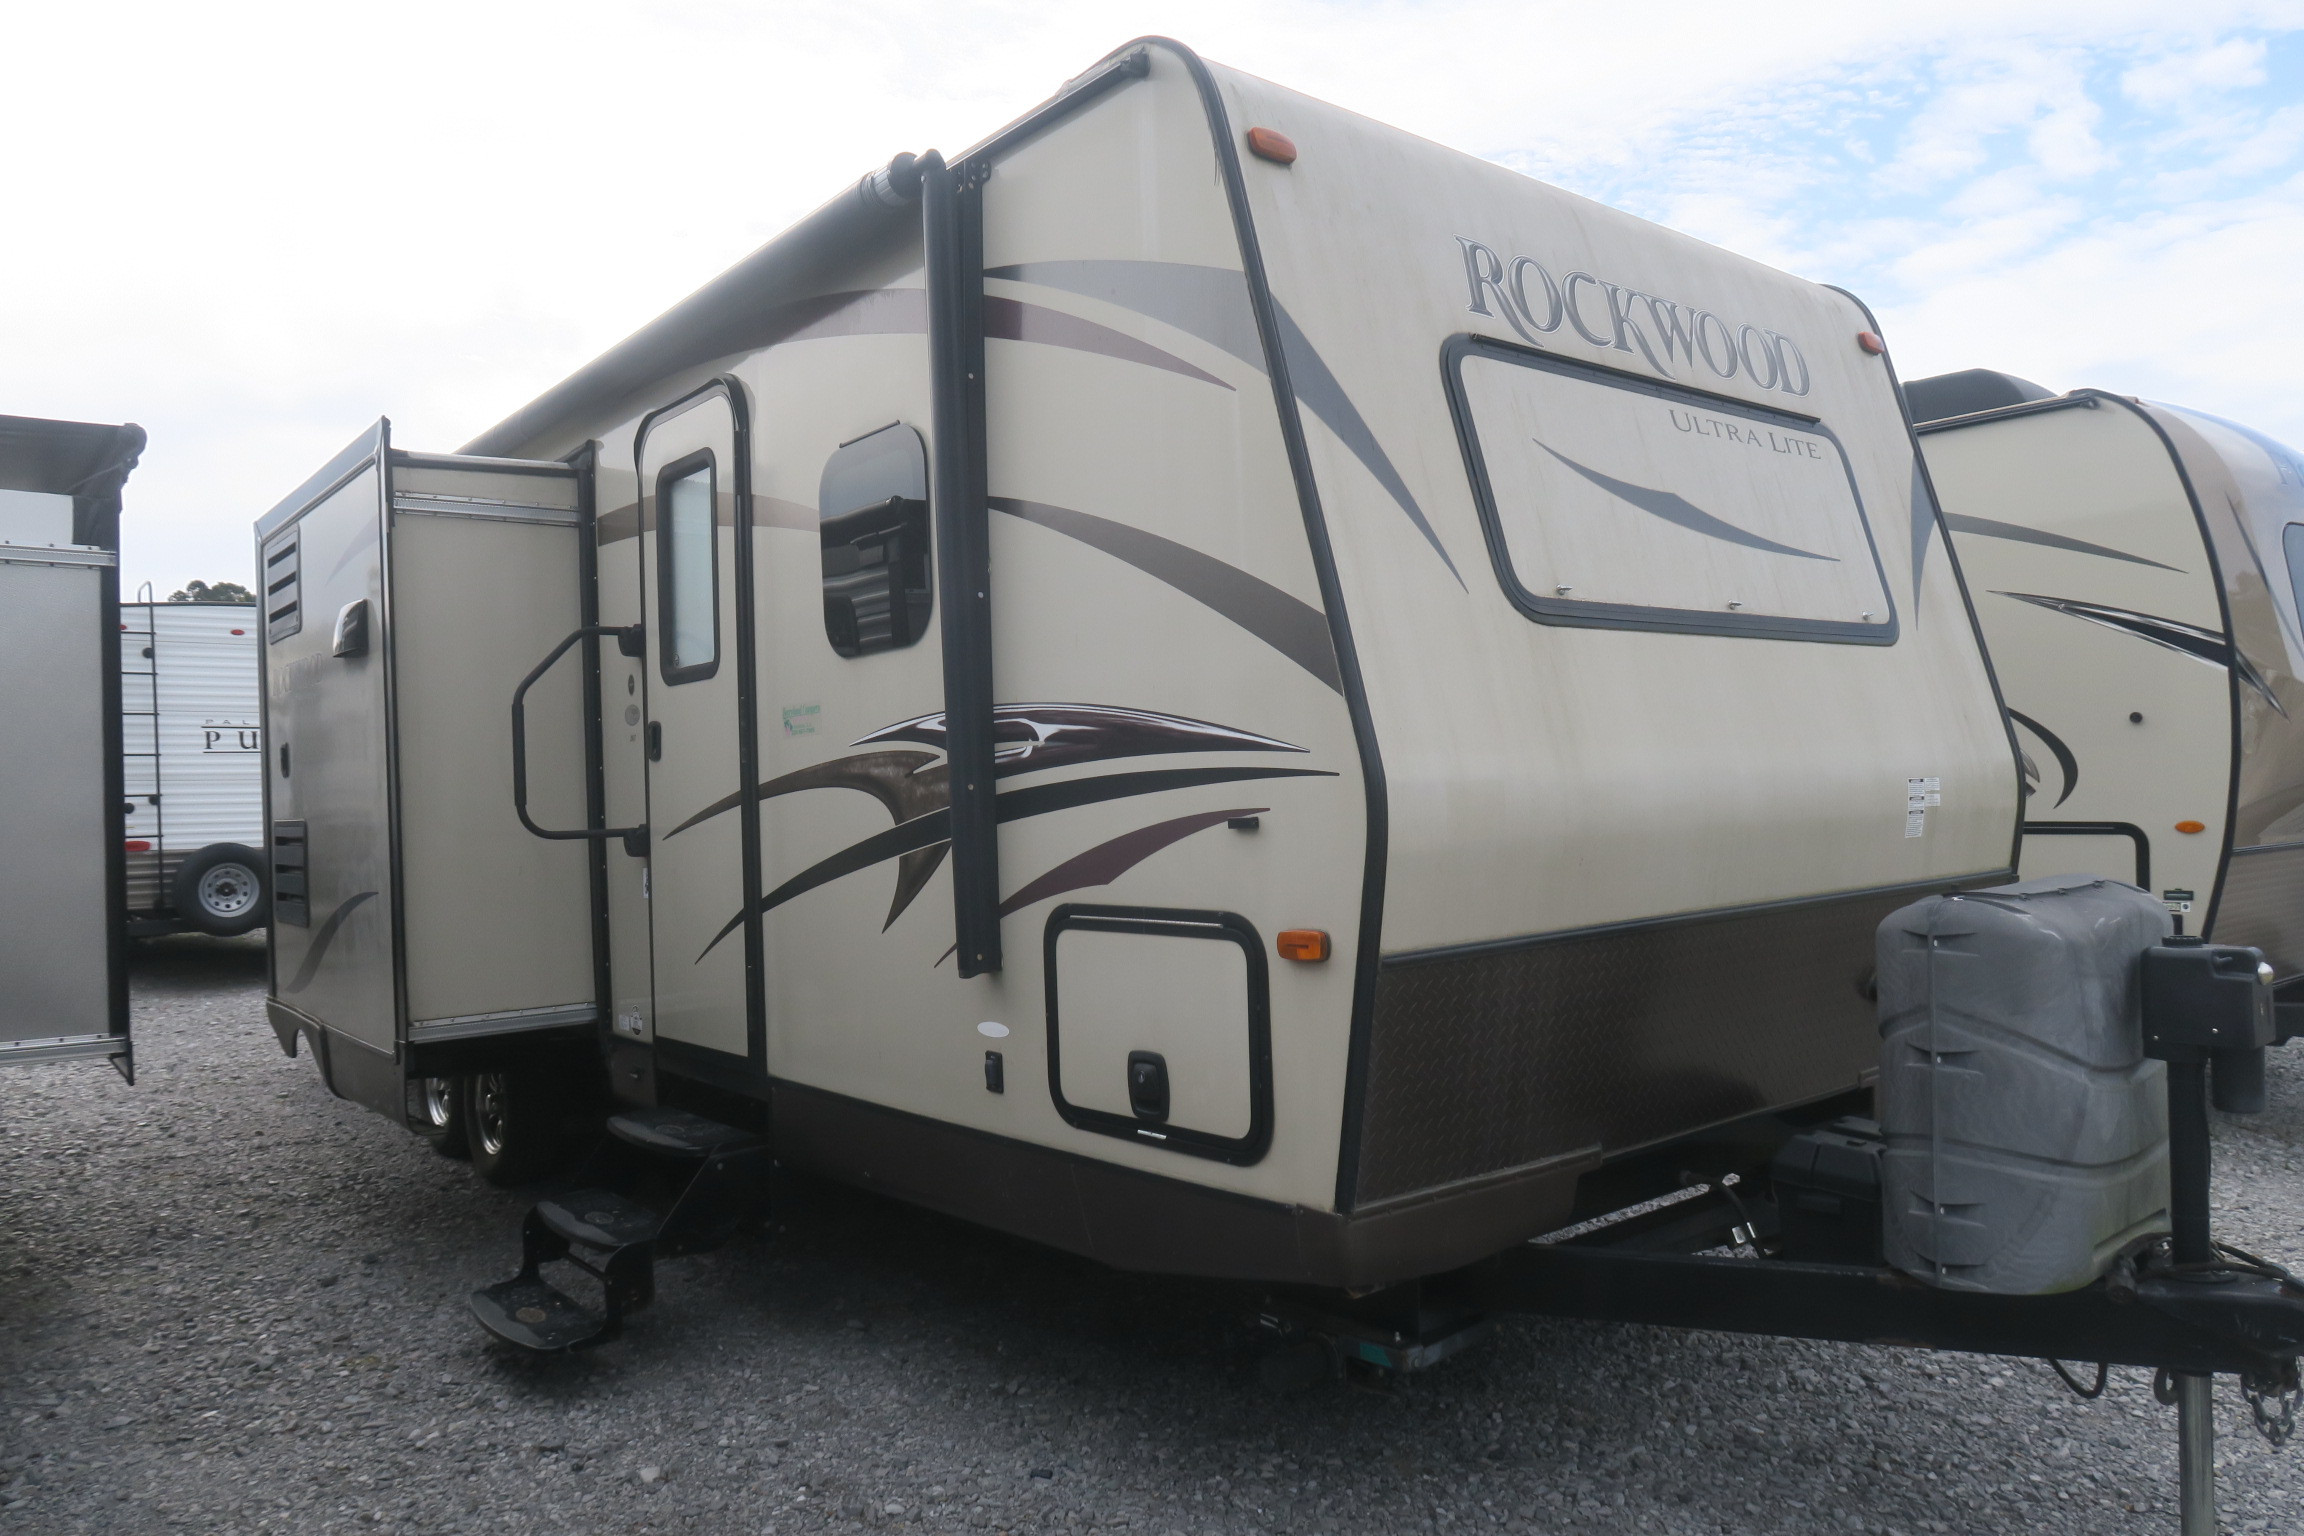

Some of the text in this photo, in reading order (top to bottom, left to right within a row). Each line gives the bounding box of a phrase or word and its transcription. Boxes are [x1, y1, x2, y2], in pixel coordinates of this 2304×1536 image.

[1454, 234, 1811, 397] ROCKWOOD
[1669, 409, 1822, 460] ULTRA LITE
[203, 730, 260, 750] PU
